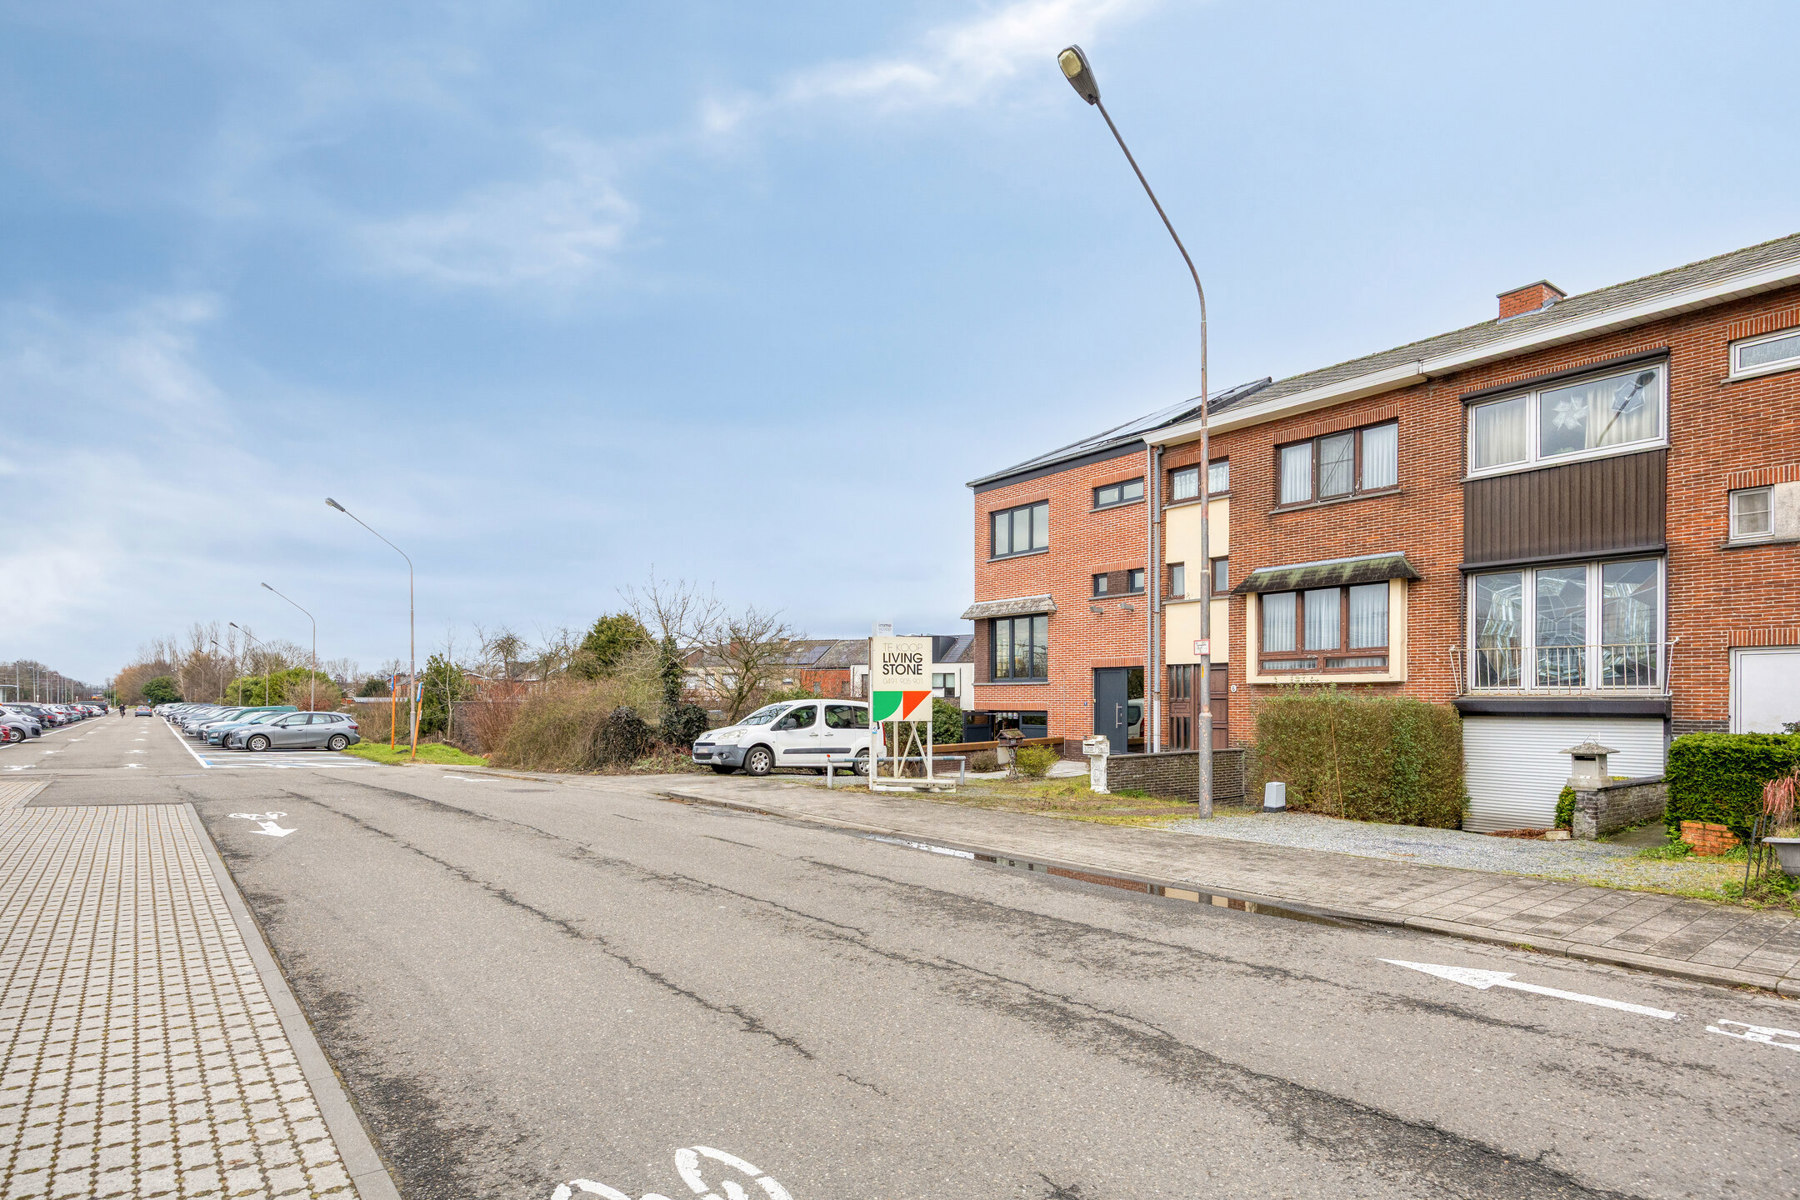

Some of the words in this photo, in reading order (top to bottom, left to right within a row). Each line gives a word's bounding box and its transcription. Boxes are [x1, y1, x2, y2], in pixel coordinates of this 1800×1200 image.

[882, 642, 893, 652] TE
[896, 642, 924, 652] KOOP
[882, 652, 923, 664] LIVING
[882, 663, 923, 675] STONE
